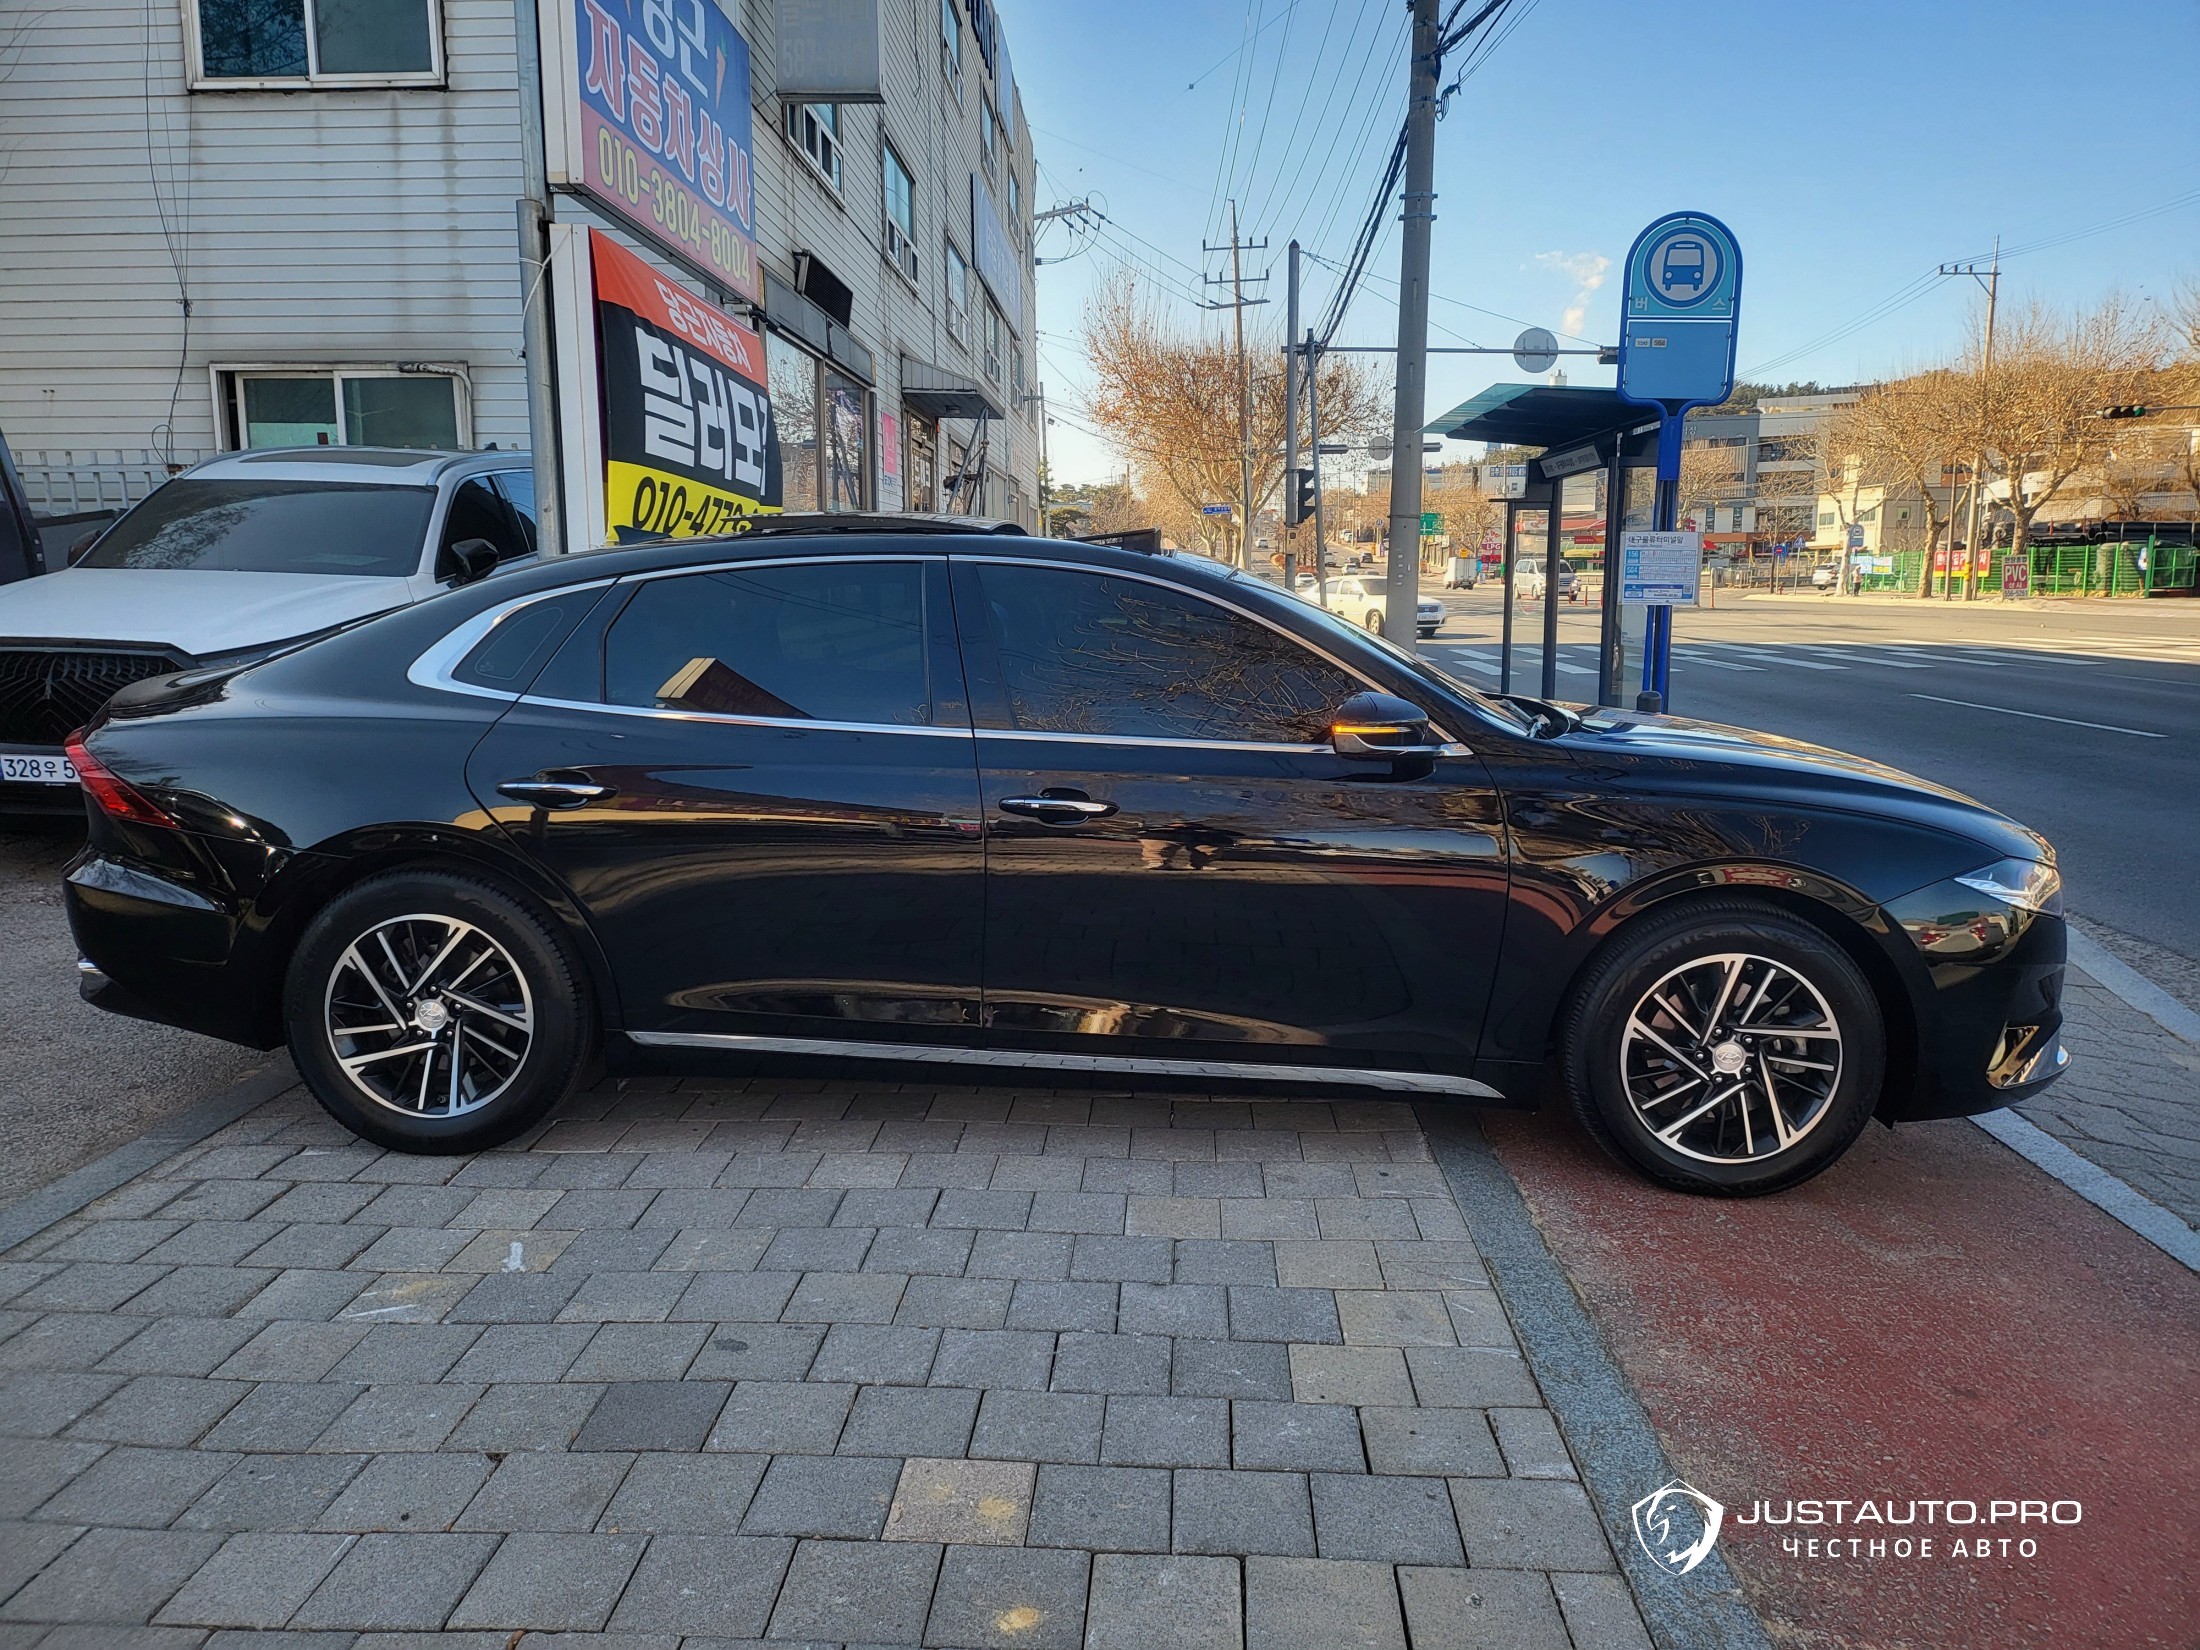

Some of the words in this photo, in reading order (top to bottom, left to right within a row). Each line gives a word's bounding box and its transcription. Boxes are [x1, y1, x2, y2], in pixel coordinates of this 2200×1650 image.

[584, 0, 752, 231] 자동차상사
[597, 127, 752, 287] 010-3804-8004
[653, 278, 753, 374] 당근자동차
[1635, 296, 1648, 311] 버
[1711, 297, 1727, 311] 스
[2004, 565, 2027, 582] PVC
[4, 758, 58, 778] 328우
